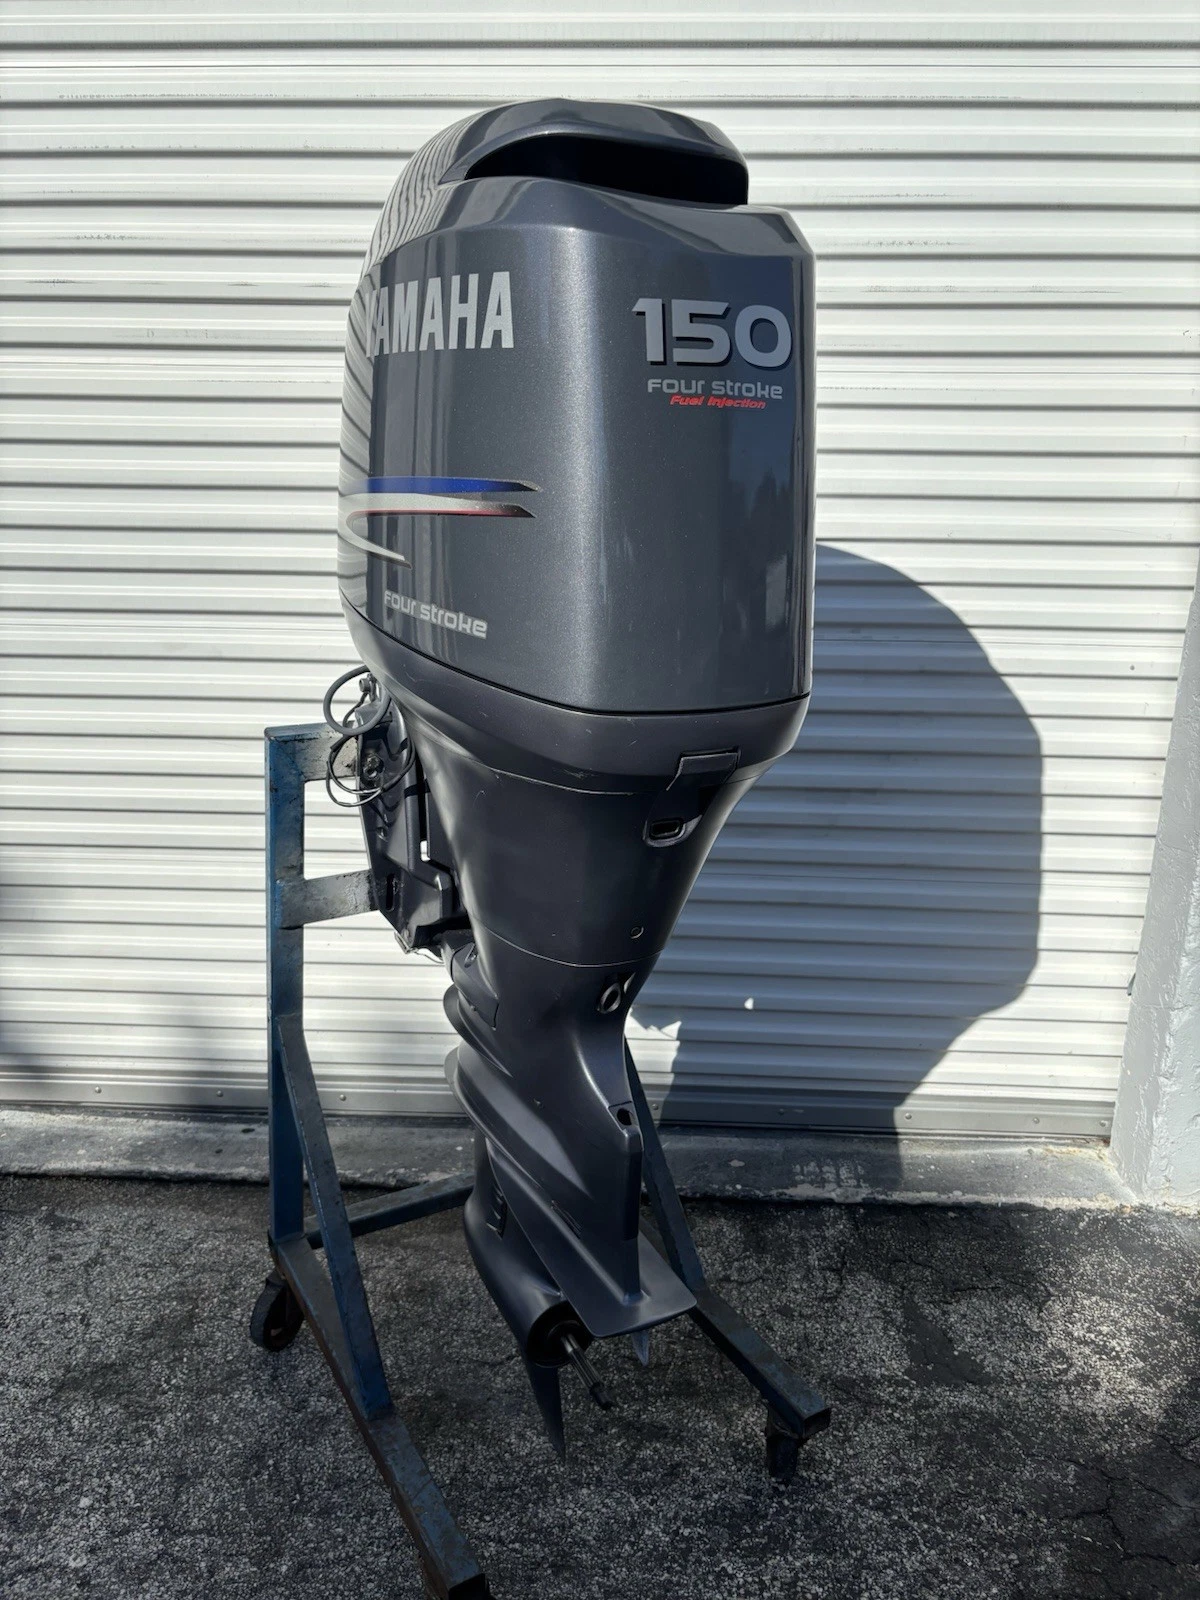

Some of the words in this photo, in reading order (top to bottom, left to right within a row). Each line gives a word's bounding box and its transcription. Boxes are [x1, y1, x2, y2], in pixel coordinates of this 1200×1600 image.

[365, 271, 514, 358] YAMAHA
[632, 298, 792, 370] 150
[670, 394, 704, 406] Fuel
